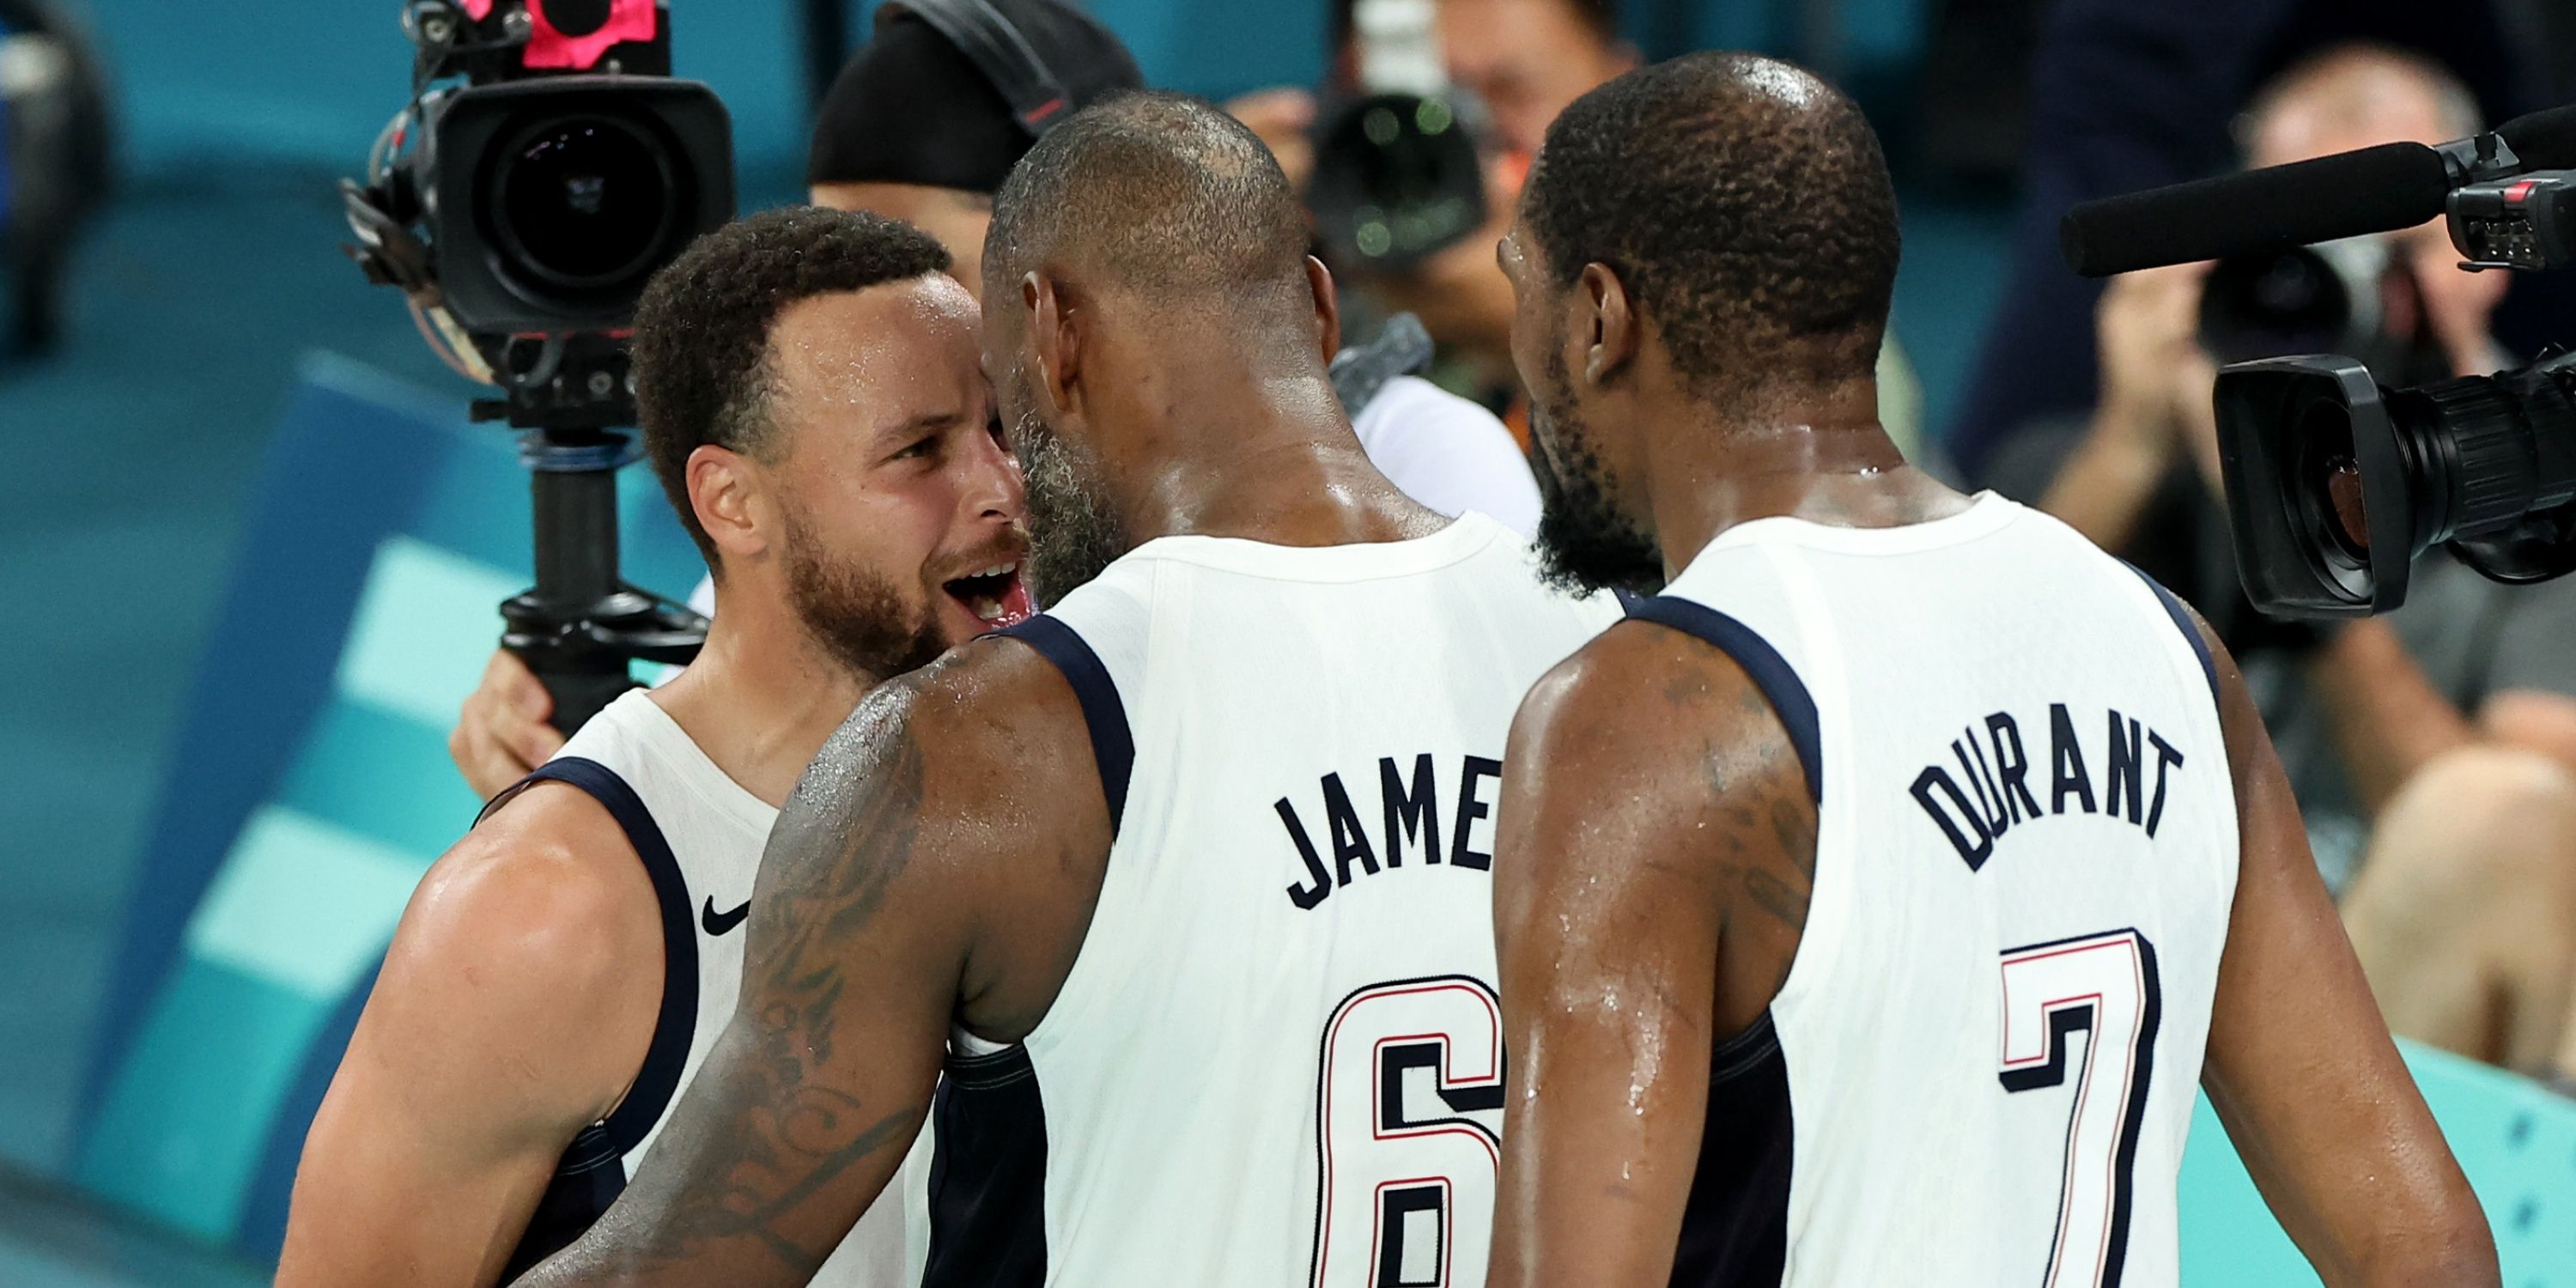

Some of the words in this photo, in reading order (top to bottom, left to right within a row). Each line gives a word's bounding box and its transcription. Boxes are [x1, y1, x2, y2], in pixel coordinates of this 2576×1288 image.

[1909, 703, 2184, 873] DURANT
[1311, 975, 1504, 1288] 6
[1999, 927, 2162, 1288] 7
